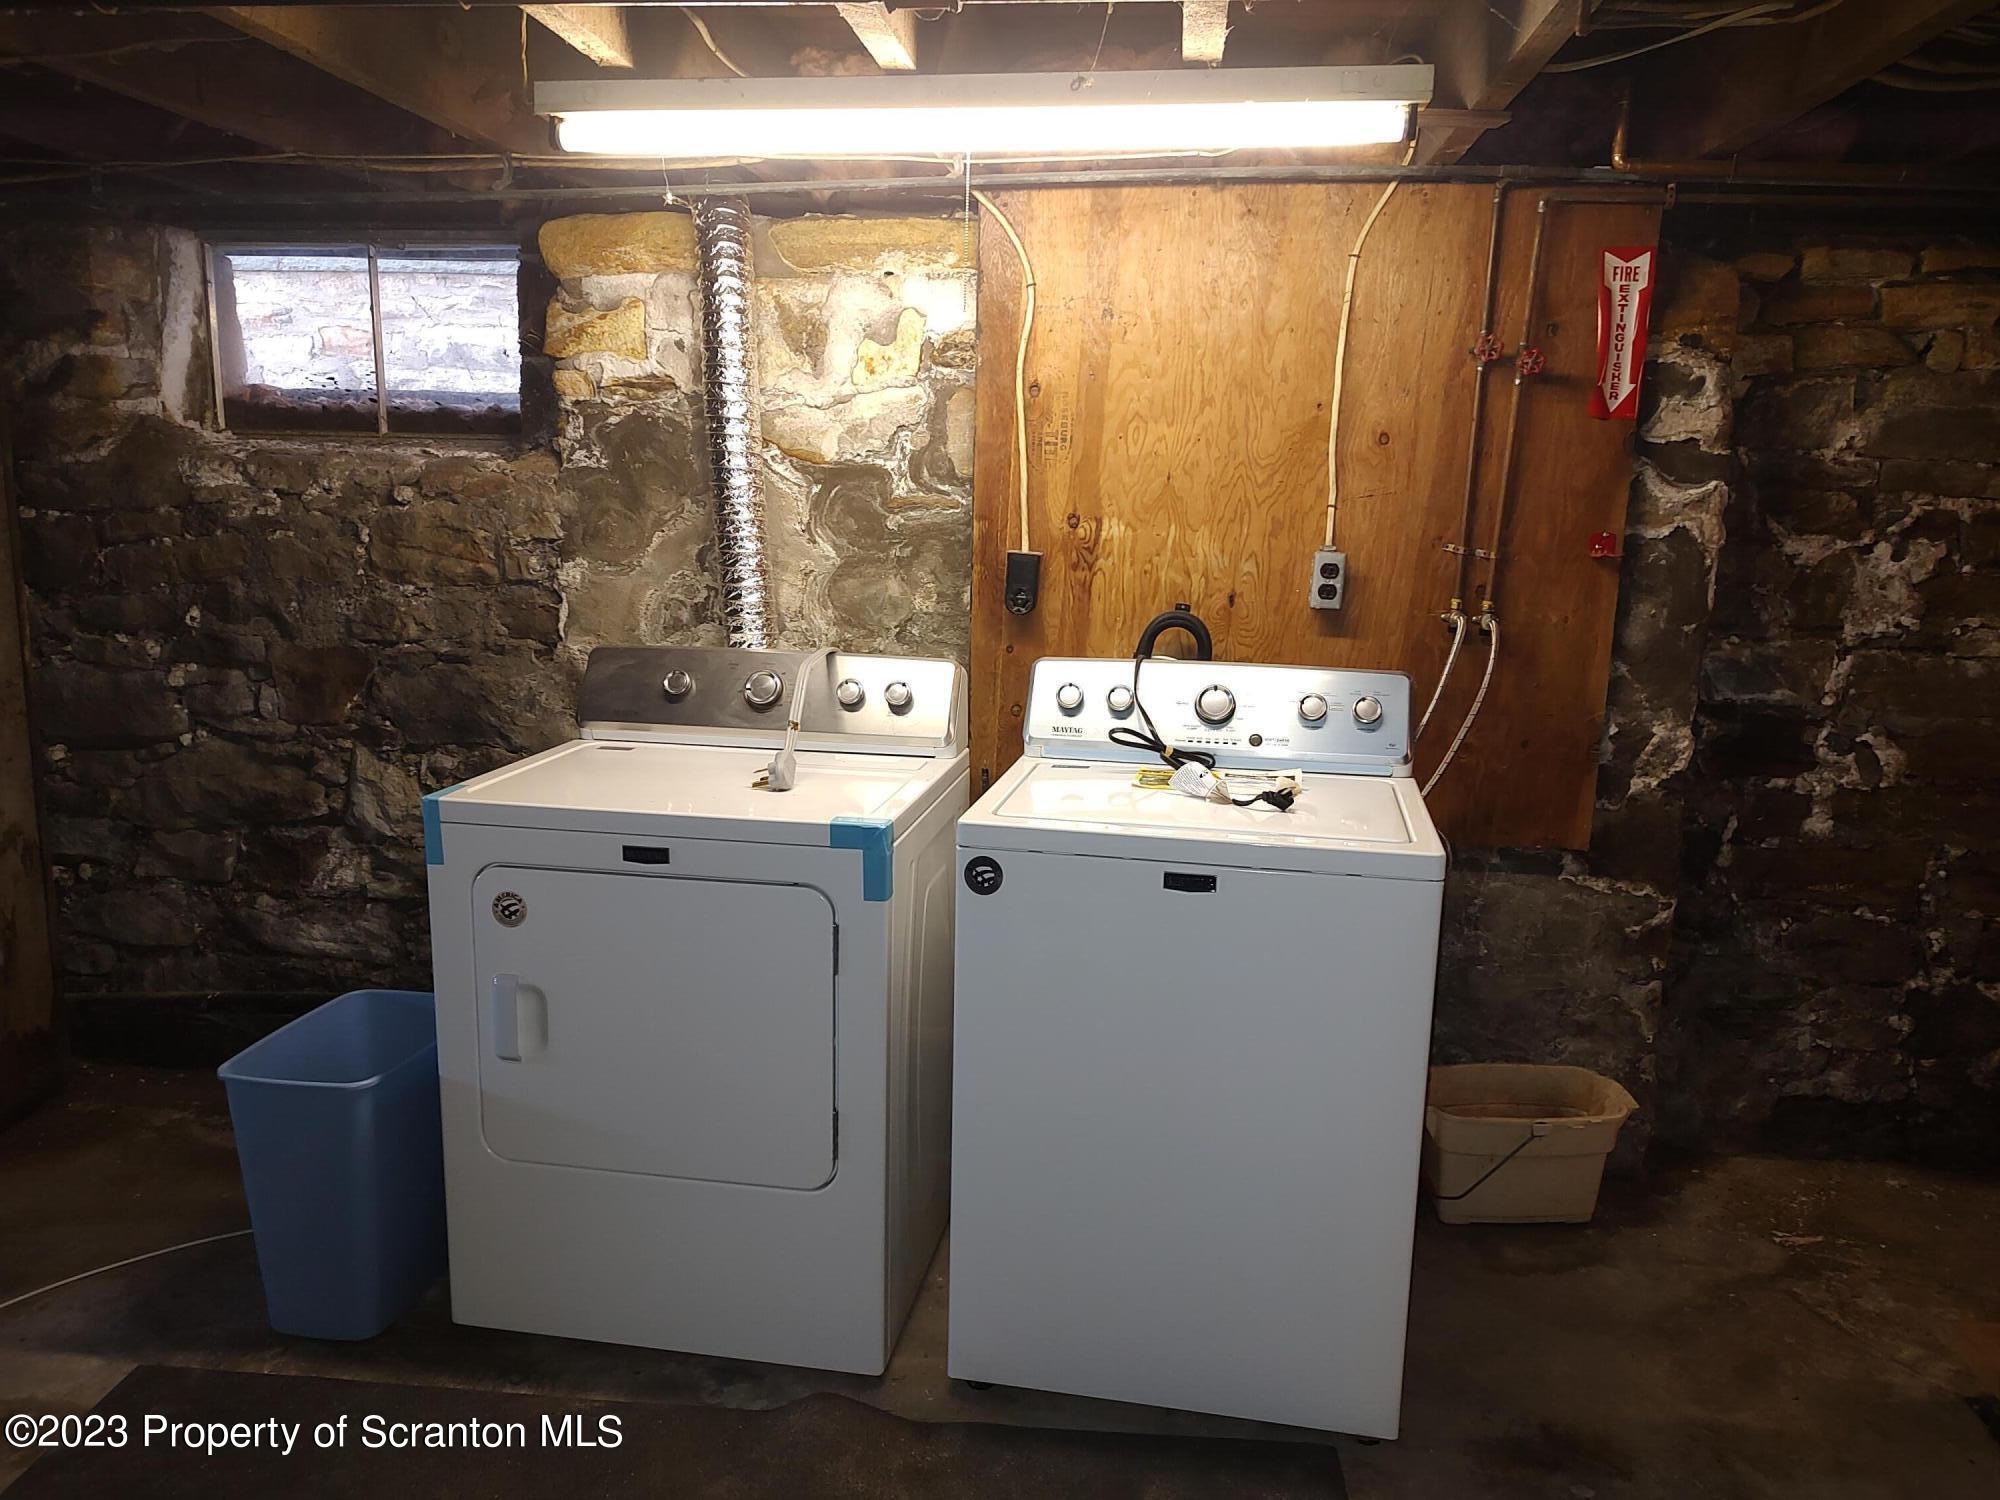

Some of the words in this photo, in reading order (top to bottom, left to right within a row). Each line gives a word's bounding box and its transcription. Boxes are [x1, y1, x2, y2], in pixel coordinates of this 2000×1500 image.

[1612, 266, 1641, 282] FIRE
[1609, 284, 1630, 401] EXTINGUISHER
[1051, 726, 1083, 734] MAYTAG
